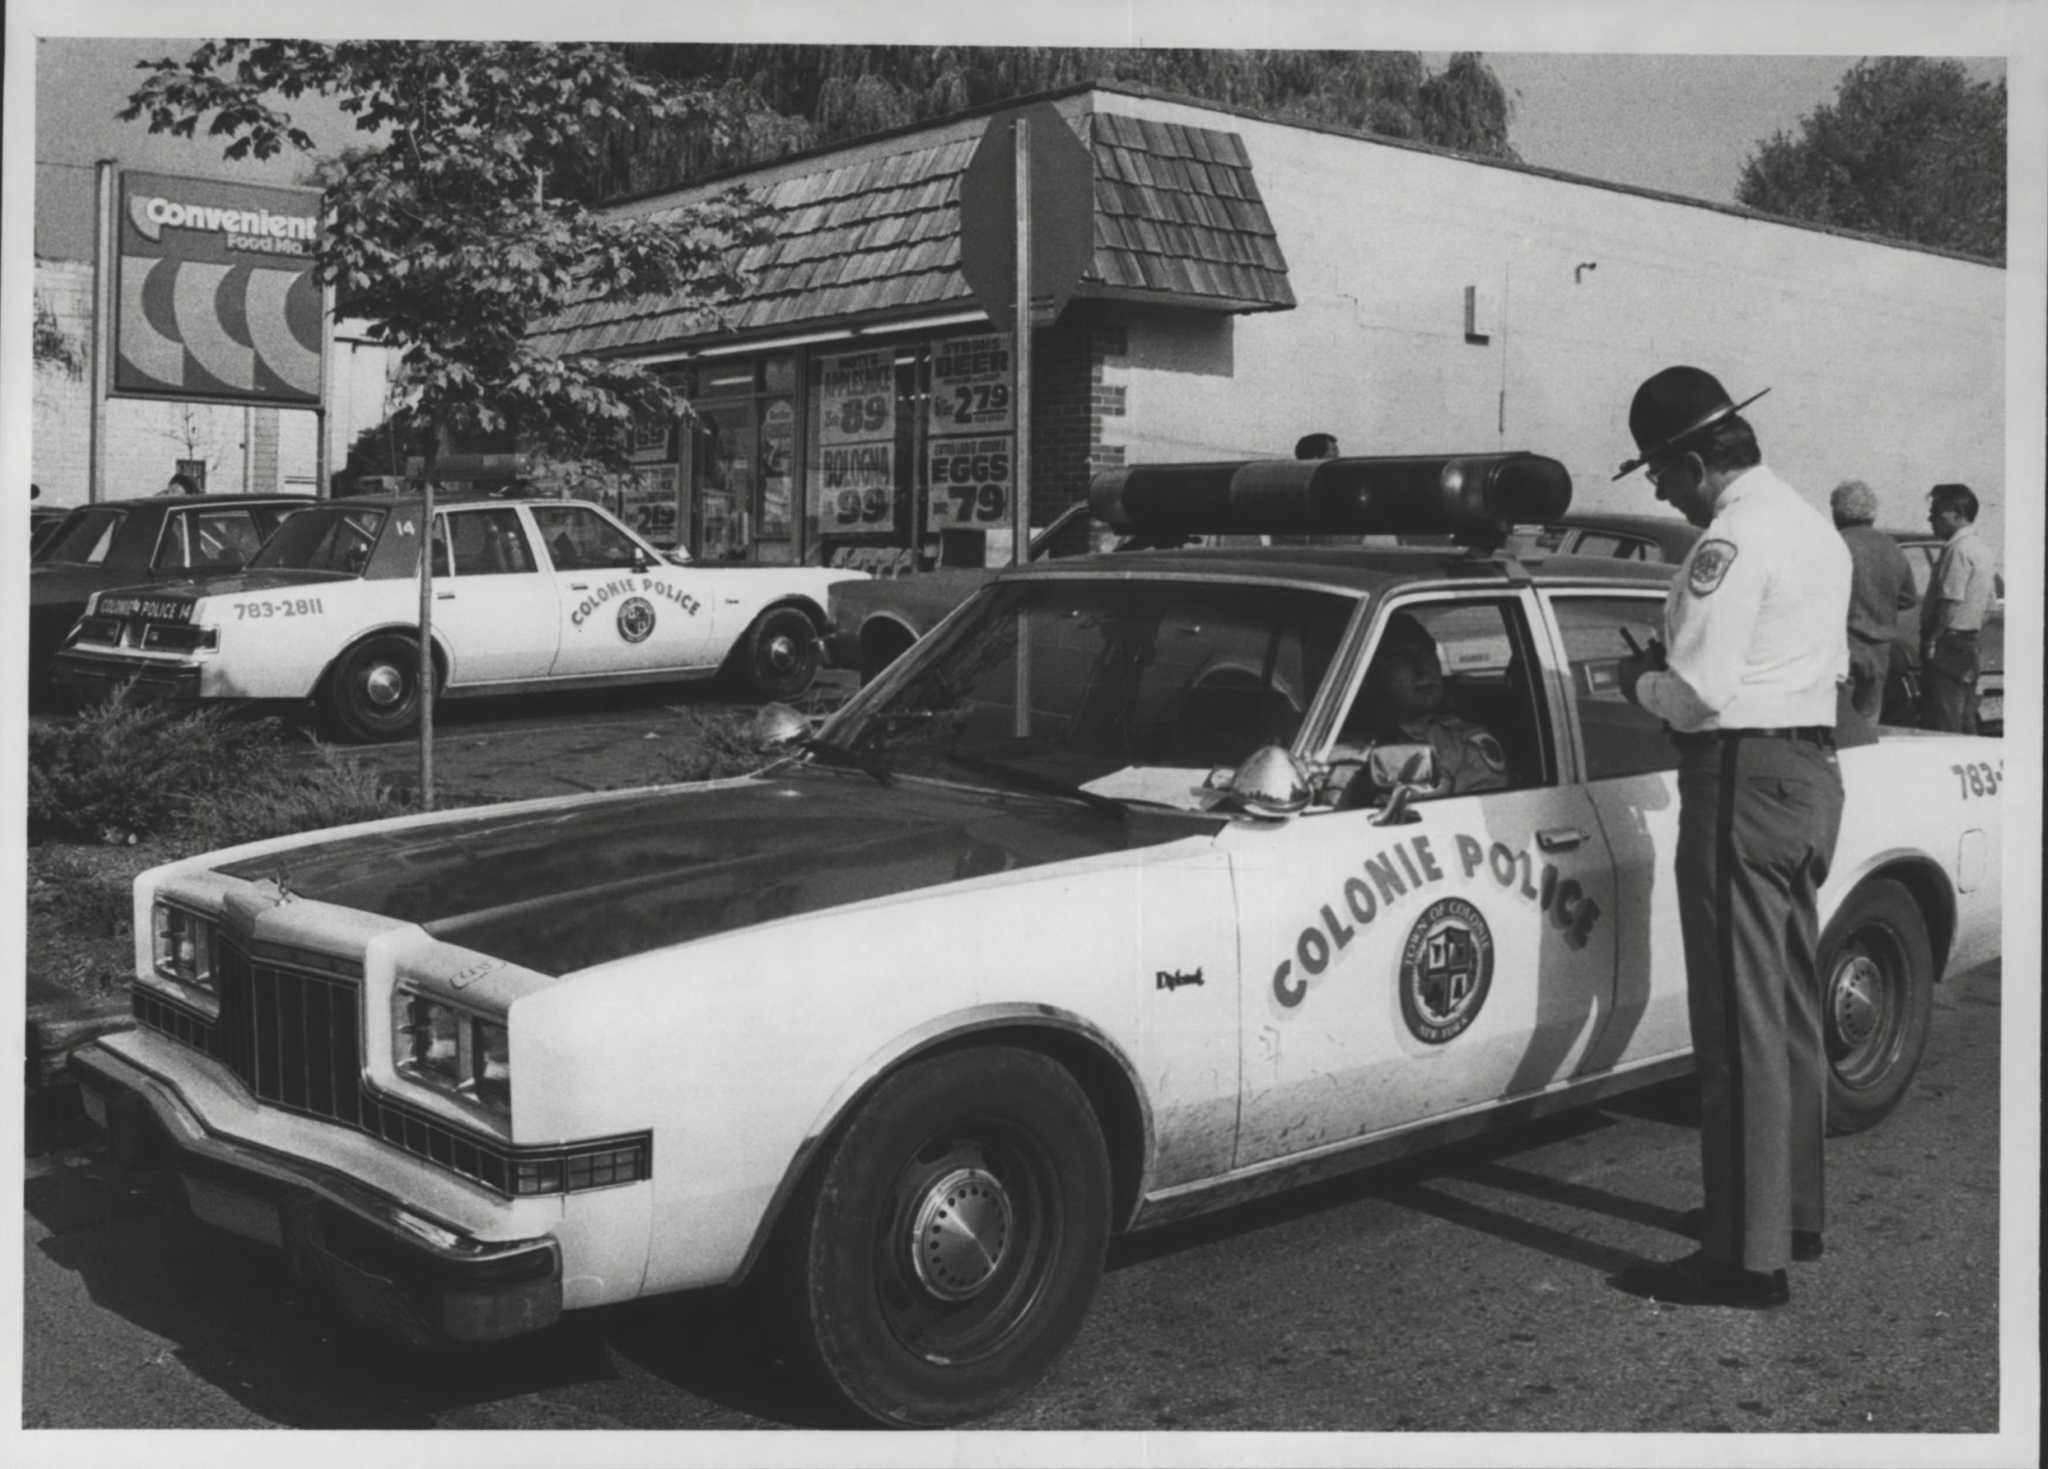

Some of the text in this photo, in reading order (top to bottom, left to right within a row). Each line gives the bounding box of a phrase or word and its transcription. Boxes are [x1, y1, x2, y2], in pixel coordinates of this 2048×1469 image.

[227, 233, 272, 251] Food
[935, 350, 1008, 378] BEER
[841, 396, 887, 433] 89
[932, 454, 1008, 483] EGGS
[838, 488, 887, 524] 99
[947, 485, 1004, 522] 79
[396, 520, 416, 536] 14
[141, 601, 176, 619] POLICE
[233, 598, 323, 620] 783-2811
[571, 579, 636, 625] COLONIE
[643, 579, 700, 616] POLICE
[1950, 759, 2004, 800] 783-
[1273, 834, 1601, 1008] COLONIE POLICE
[1429, 905, 1445, 921] OF
[1450, 902, 1491, 949] COLONIE
